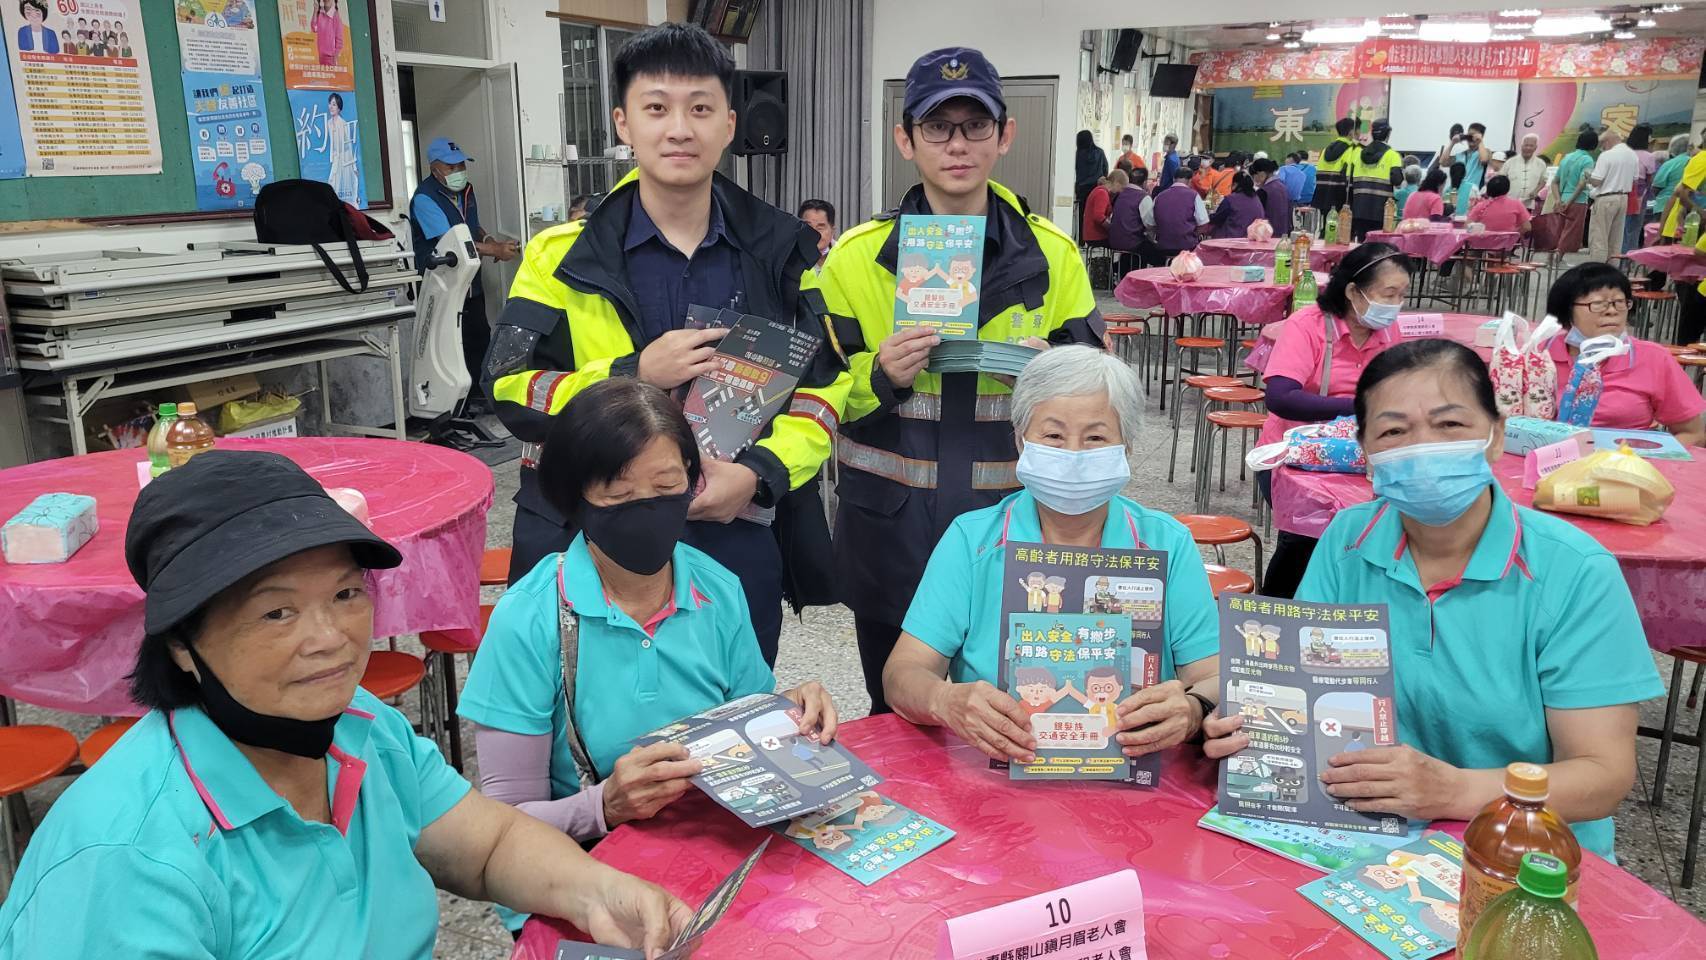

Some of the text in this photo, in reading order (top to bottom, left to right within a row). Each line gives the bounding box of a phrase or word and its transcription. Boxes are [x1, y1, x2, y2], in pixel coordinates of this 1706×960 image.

[1015, 547, 1160, 571] 高齡者用路守法保平安
[1229, 597, 1380, 622] 高齡者用路守法保平安
[1054, 721, 1084, 731] 銀髮族
[1378, 699, 1389, 742] 行人禁止穿越
[1038, 731, 1100, 741] 交通安全手冊
[1045, 897, 1072, 928] 10
